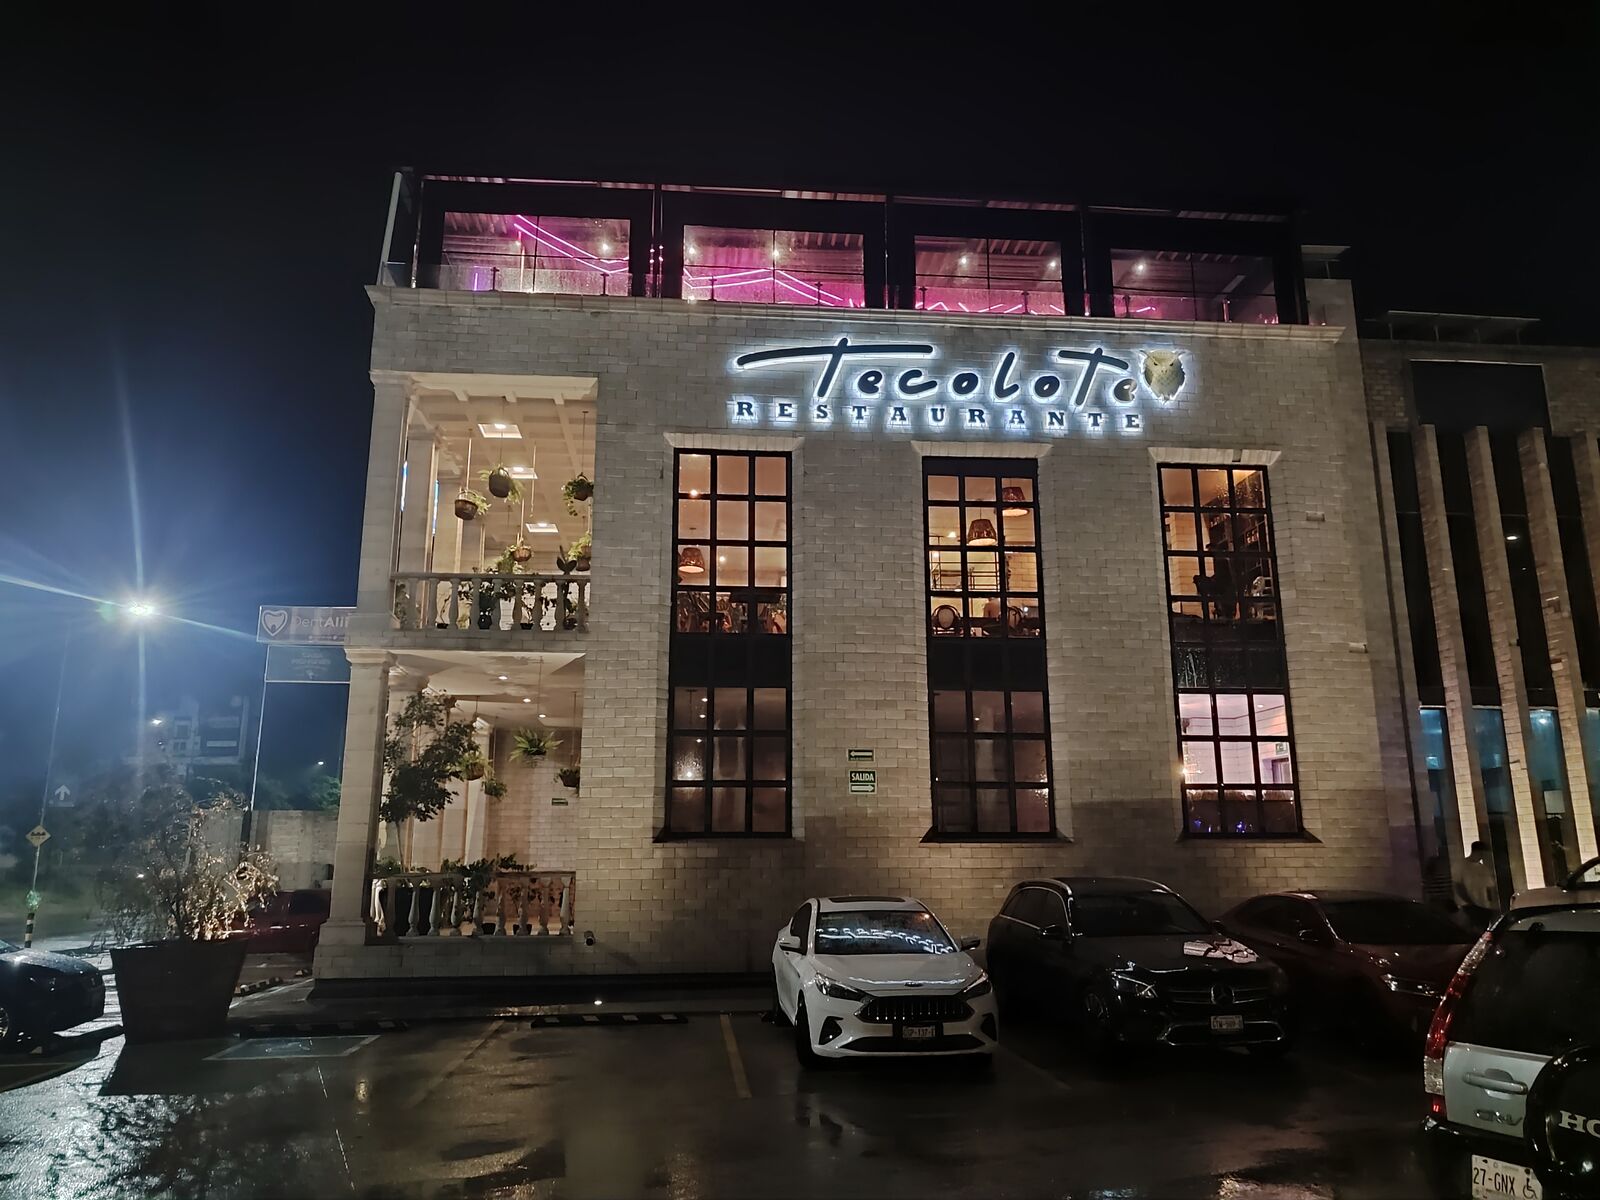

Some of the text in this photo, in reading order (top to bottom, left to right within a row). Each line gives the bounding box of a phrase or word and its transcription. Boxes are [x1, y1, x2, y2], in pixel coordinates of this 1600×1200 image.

[736, 401, 1140, 429] RESTAURANTE
[851, 772, 874, 781] SALIDA
[1472, 1166, 1516, 1197] 27-GNX
